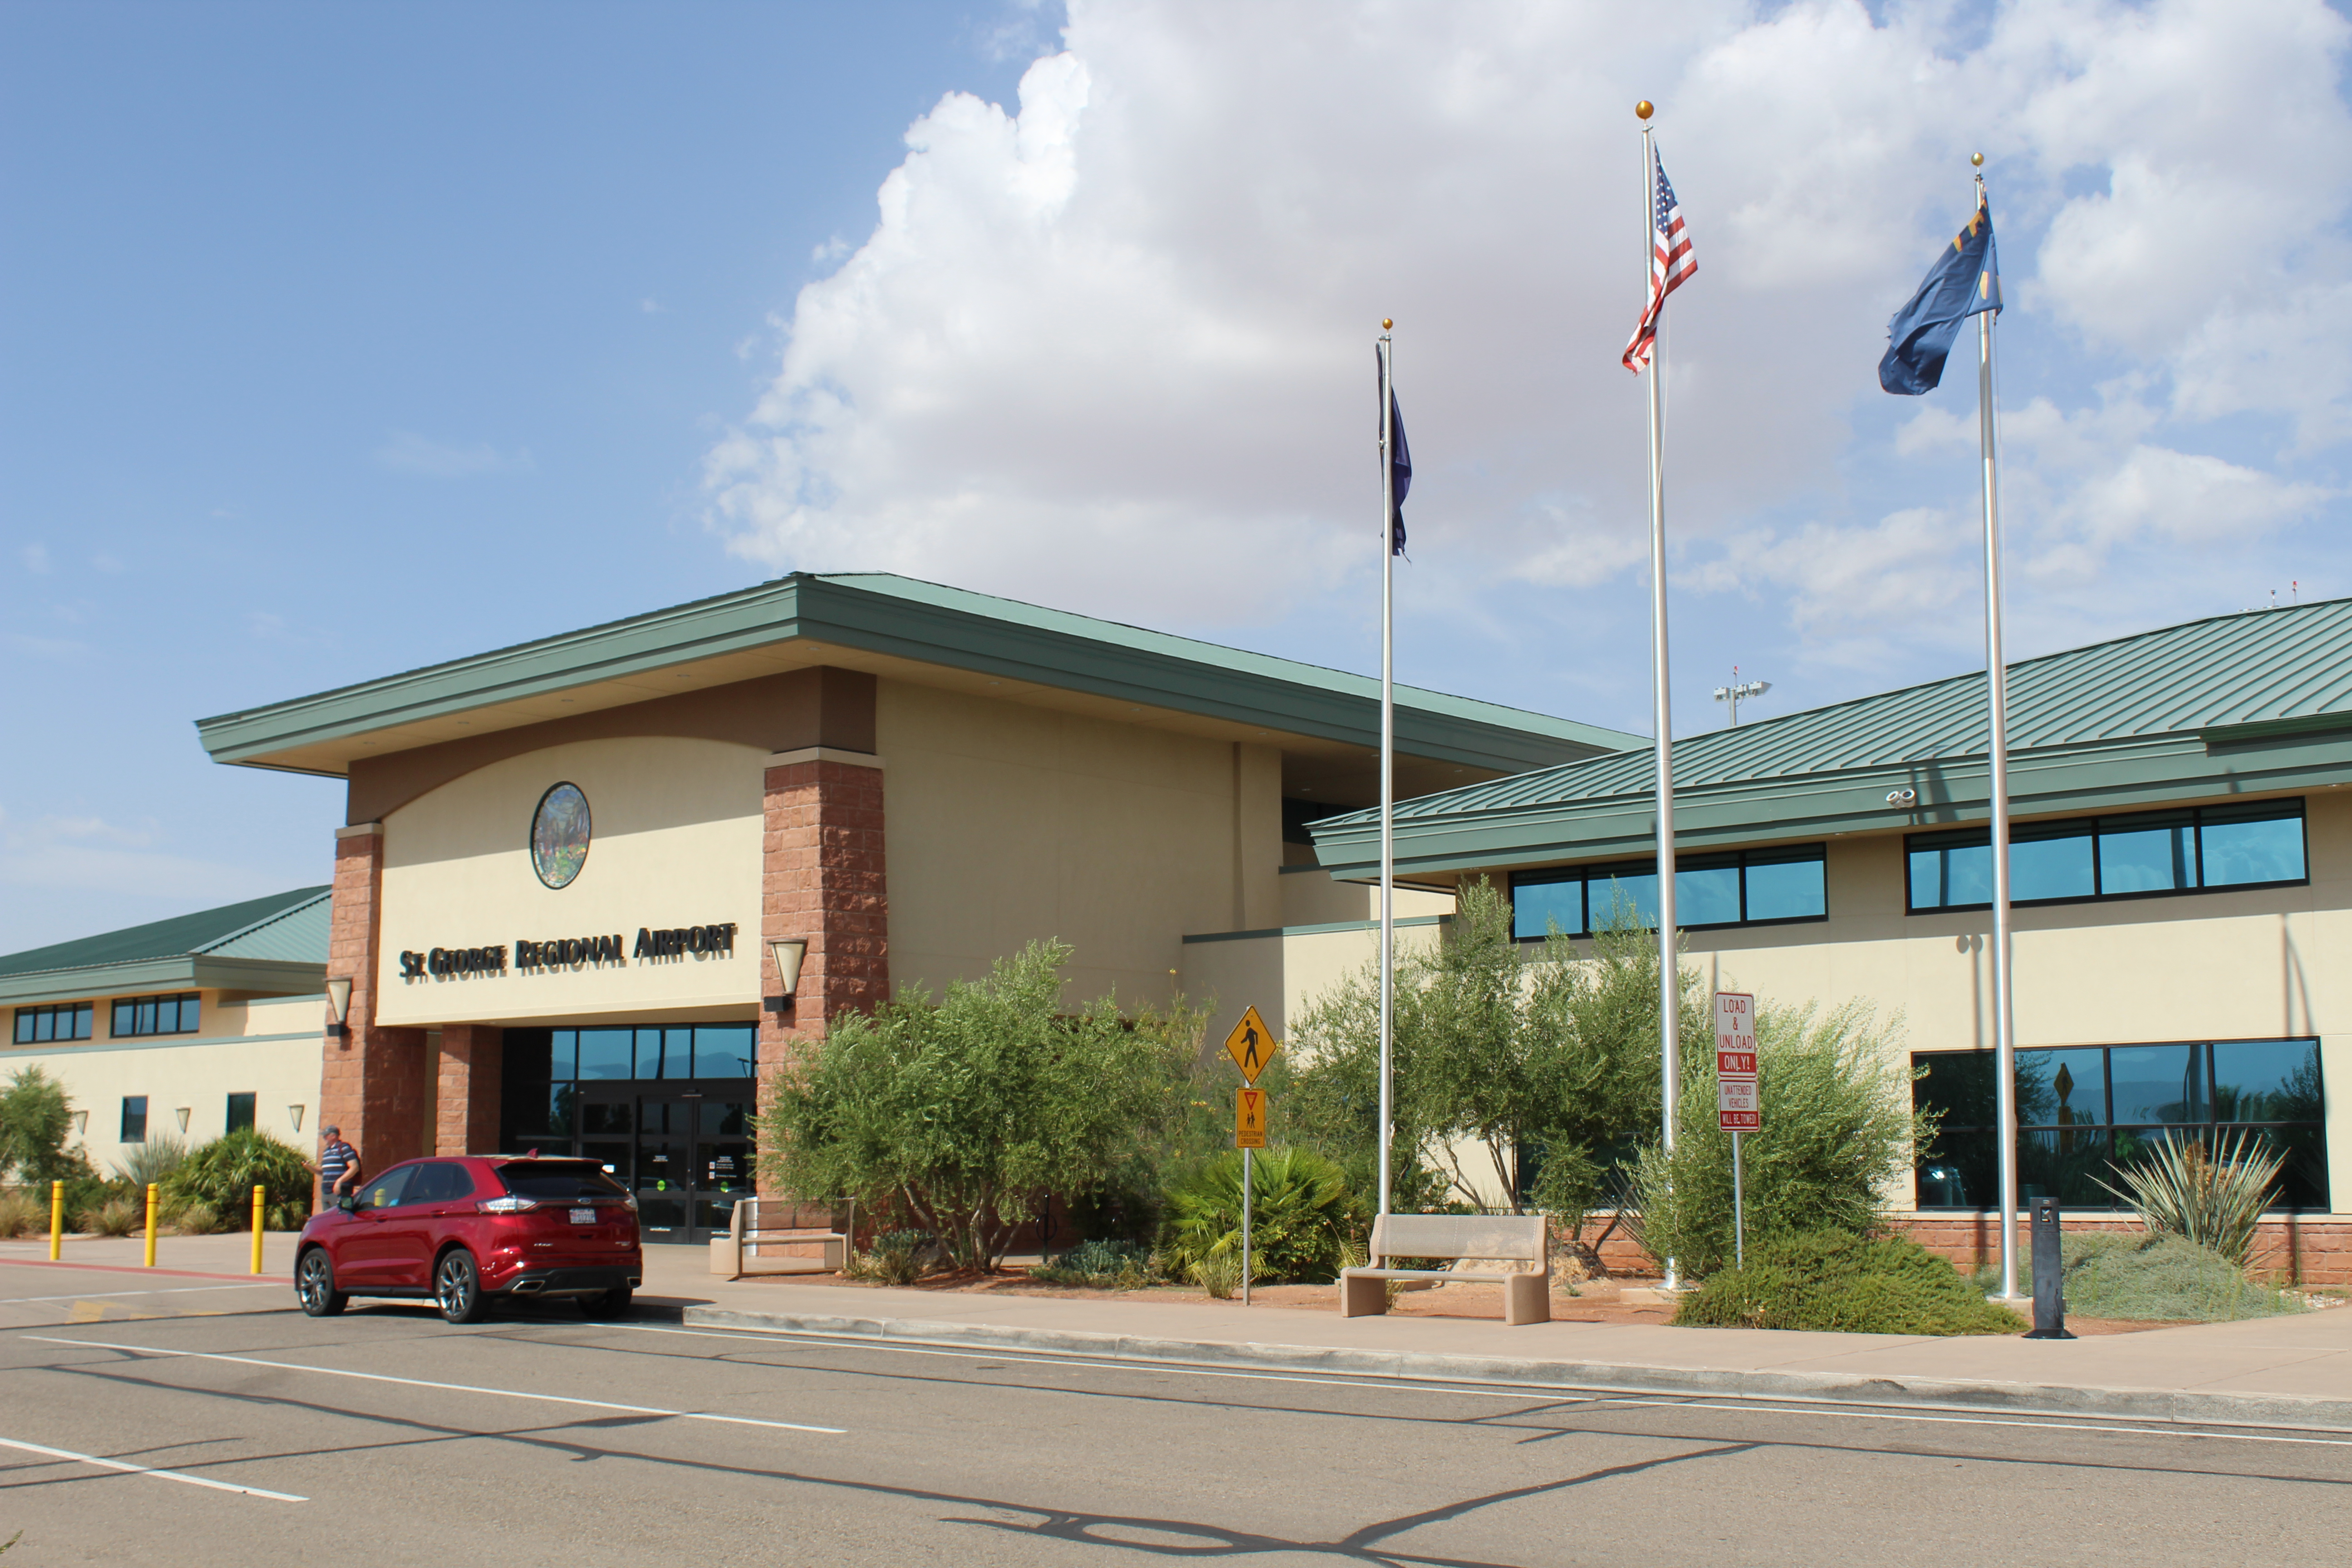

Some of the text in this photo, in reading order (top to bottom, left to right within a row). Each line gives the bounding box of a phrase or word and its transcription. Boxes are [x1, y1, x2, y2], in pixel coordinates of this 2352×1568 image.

[428, 946, 505, 975] GEORGE
[515, 934, 624, 968] REGIONAL
[632, 922, 736, 958] AIRPORT
[1724, 999, 1746, 1014] LOAD
[1733, 1017, 1739, 1030] &
[1719, 1034, 1753, 1049] UNLOAD
[1724, 1055, 1750, 1070] ONLY!
[1725, 1085, 1752, 1095] UNATTENDED
[1728, 1098, 1749, 1108] VEHICLES
[1722, 1113, 1757, 1124] WILL BE TOWED!
